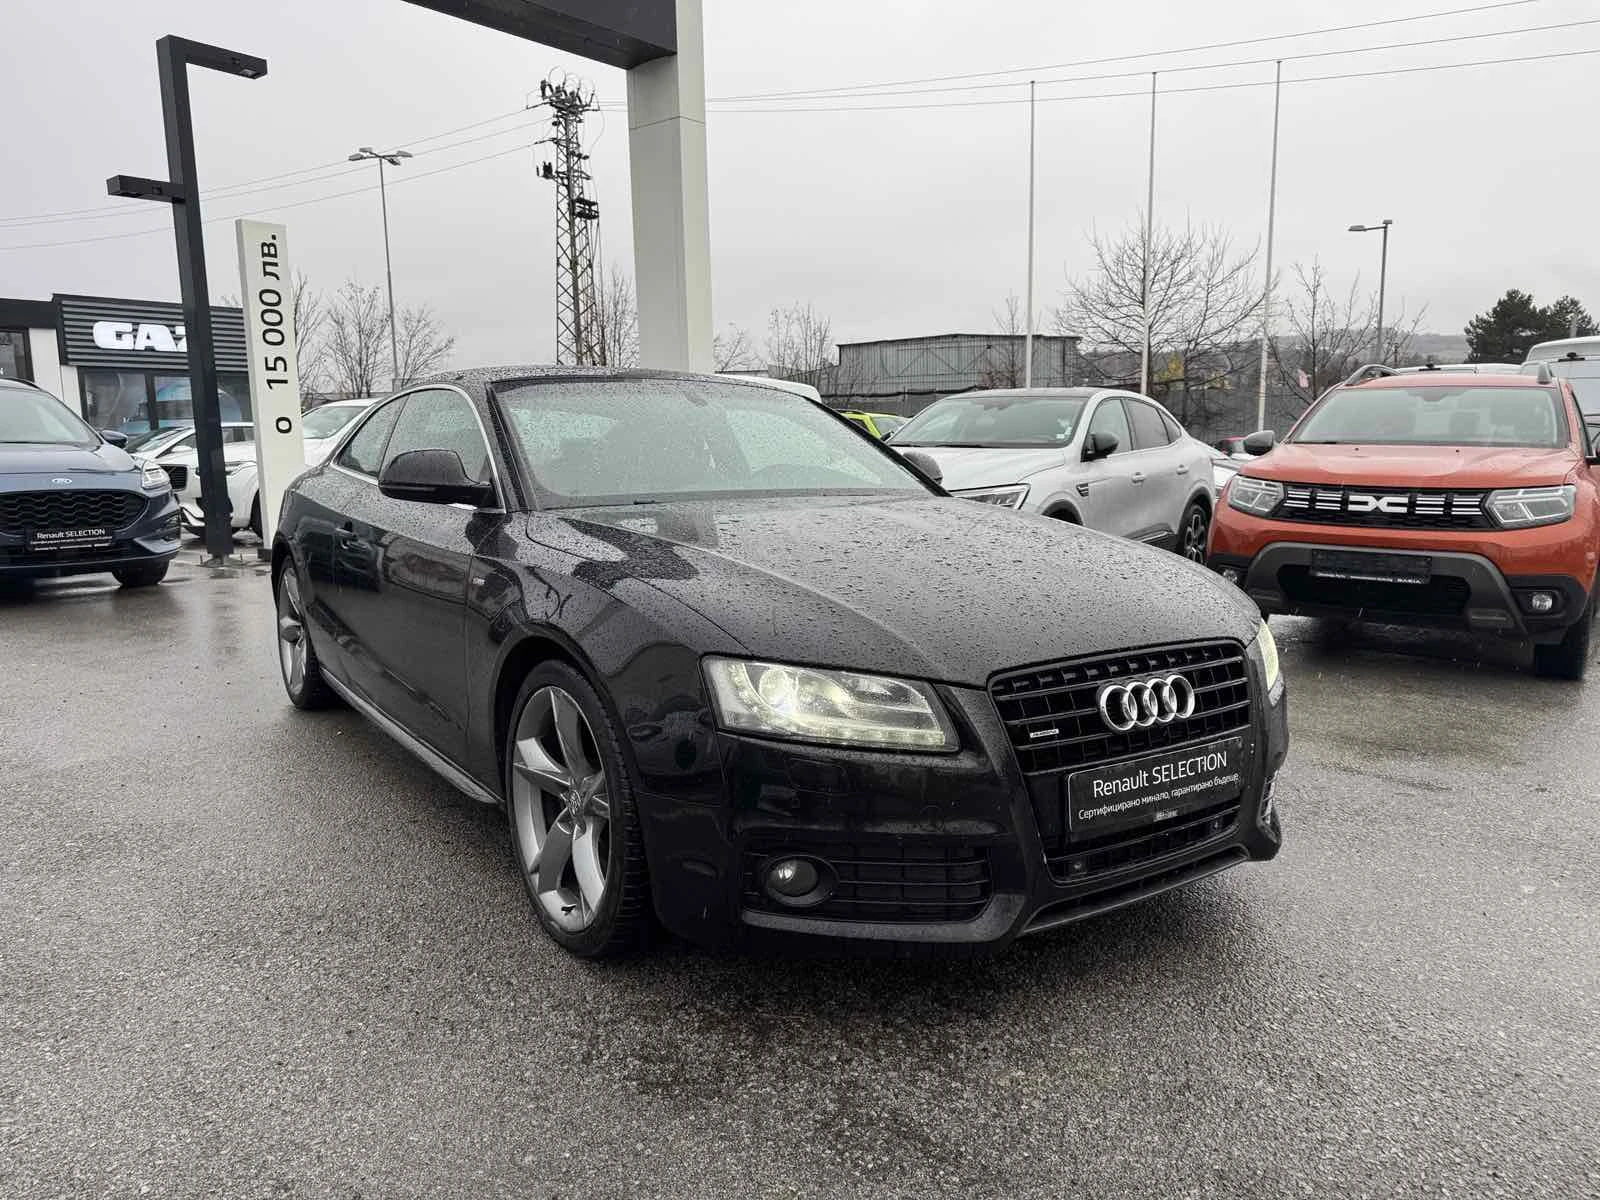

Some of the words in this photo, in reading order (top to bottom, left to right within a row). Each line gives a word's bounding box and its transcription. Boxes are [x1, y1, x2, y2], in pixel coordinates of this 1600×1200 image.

[260, 234, 281, 281] лв.
[258, 288, 285, 346] 000
[264, 356, 288, 390] 15
[36, 531, 65, 540] Renault
[65, 528, 106, 538] SELECTION
[1092, 769, 1150, 798] Renault
[1152, 750, 1228, 785] SELECTION
[1077, 797, 1141, 821] Сертифицирано
[1171, 779, 1214, 798] гарантирано
